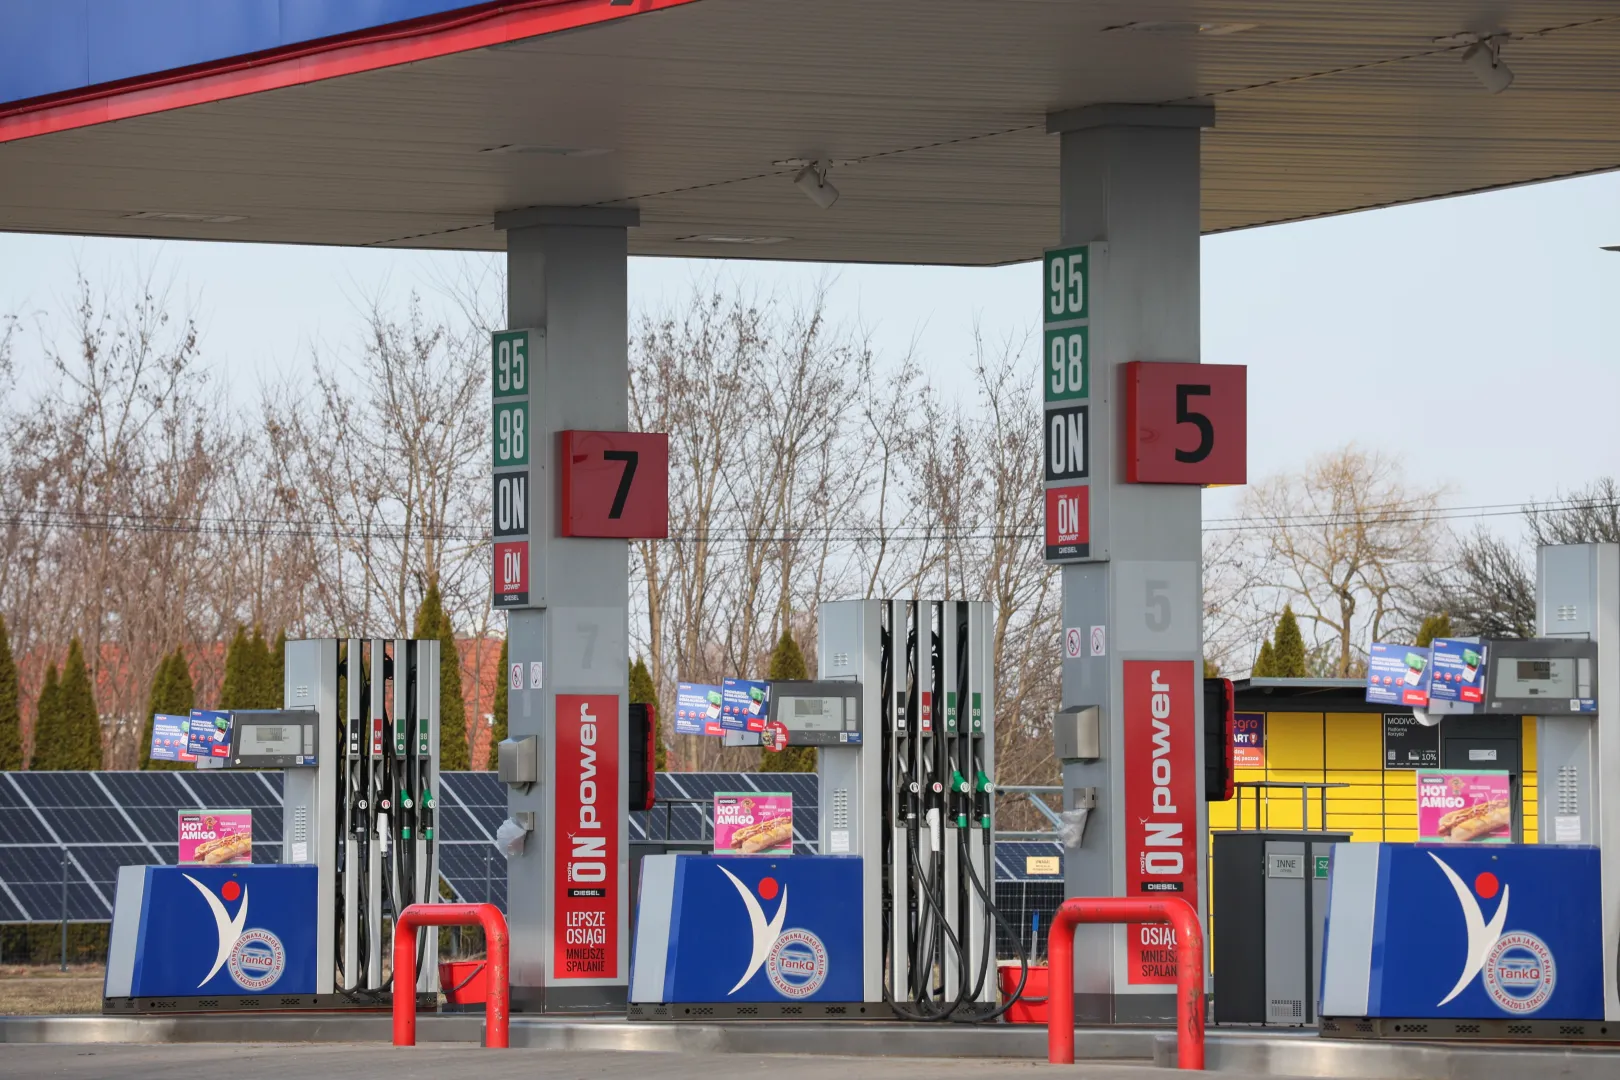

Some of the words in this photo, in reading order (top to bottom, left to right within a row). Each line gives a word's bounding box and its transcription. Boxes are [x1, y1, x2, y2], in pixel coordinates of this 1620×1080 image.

[1050, 254, 1083, 315] 95
[498, 338, 525, 391] 95
[1051, 334, 1083, 394] 98
[1174, 384, 1215, 463] 5
[500, 408, 525, 460] 98
[1050, 412, 1084, 475] ON
[603, 450, 638, 519] 7
[498, 477, 525, 531] ON
[1058, 498, 1079, 534] ON
[1058, 534, 1079, 544] power
[504, 552, 520, 584] ON
[1144, 580, 1172, 632] 5
[1151, 669, 1177, 814] power
[580, 702, 601, 829] power
[1421, 786, 1447, 796] HOT
[717, 806, 740, 815] HOT
[1420, 797, 1465, 808] AMIGO
[182, 823, 203, 831] HOT
[717, 815, 754, 824] AMIGO
[181, 831, 216, 840] AMIGO
[1145, 822, 1184, 874] ON
[572, 837, 606, 882] ON
[1277, 860, 1296, 868] INNE
[566, 912, 605, 927] LEPSZE
[566, 929, 606, 948] OSIĄGI
[241, 954, 272, 966] TankQ
[566, 949, 605, 960] MNIEJSZE
[770, 933, 801, 970] KONTROLOWANA
[1141, 950, 1177, 962] MNIEJS
[1488, 937, 1521, 984] KONTROLOWANA
[1523, 938, 1547, 958] JAKOŚĆ
[566, 961, 605, 972] SPALANIE
[780, 958, 814, 970] TankQ
[1498, 968, 1540, 979] TankQ
[773, 976, 780, 984] NA
[1494, 989, 1502, 999] NA
